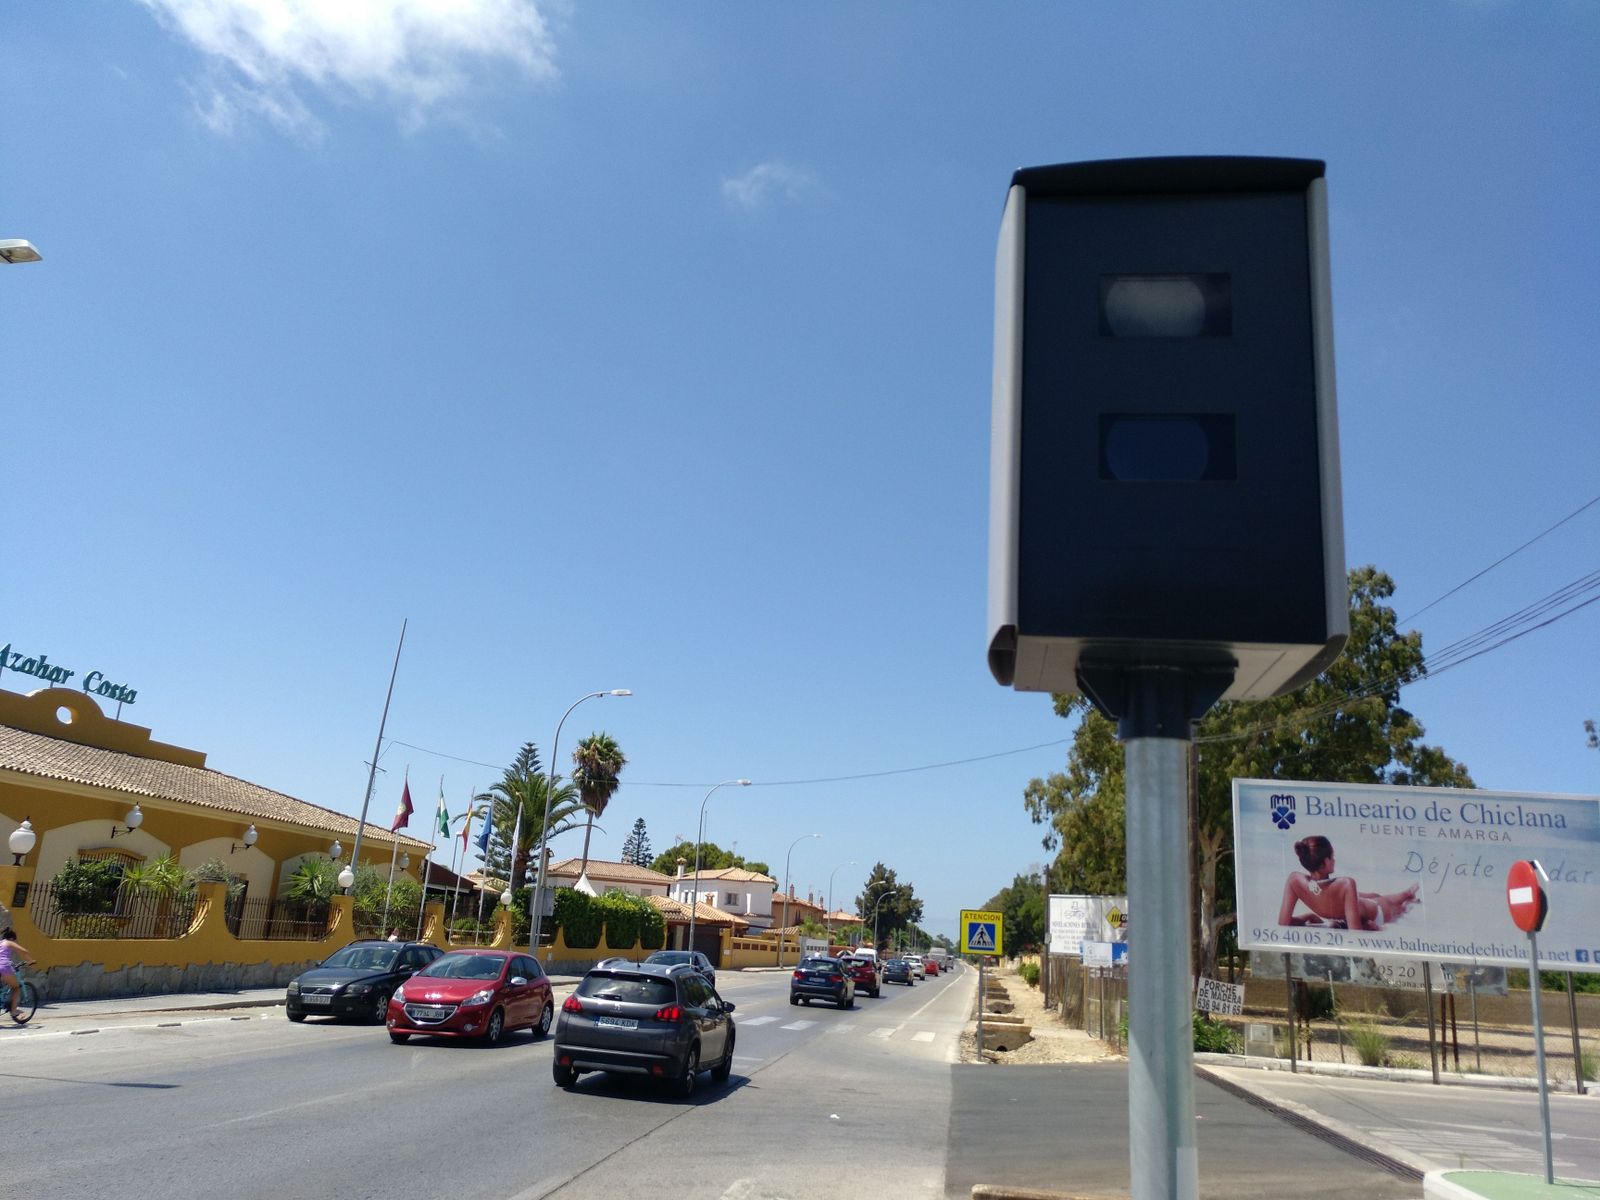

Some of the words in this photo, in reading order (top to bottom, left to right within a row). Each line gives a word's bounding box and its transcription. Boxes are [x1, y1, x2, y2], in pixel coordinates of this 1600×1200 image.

[0, 643, 74, 684] Azahar
[83, 670, 138, 704] Costa
[1305, 795, 1417, 820] Balneario
[1425, 800, 1451, 822] de
[1460, 802, 1567, 829] Chiclana
[1360, 824, 1426, 837] FUENTE
[1438, 828, 1511, 842] AMARGA
[1403, 851, 1494, 893] Déjate
[964, 912, 1001, 921] ATENCION
[1253, 928, 1279, 942] 956
[1283, 930, 1300, 943] 40
[1305, 932, 1321, 944] 05
[1326, 933, 1343, 946] 20
[1358, 936, 1571, 962] www.balneariodechiclaa.net
[1398, 967, 1415, 978] 20
[1199, 988, 1209, 998] DE
[1211, 991, 1241, 1004] MADERA
[1204, 980, 1237, 995] PORCHE
[1222, 1003, 1230, 1014] 81
